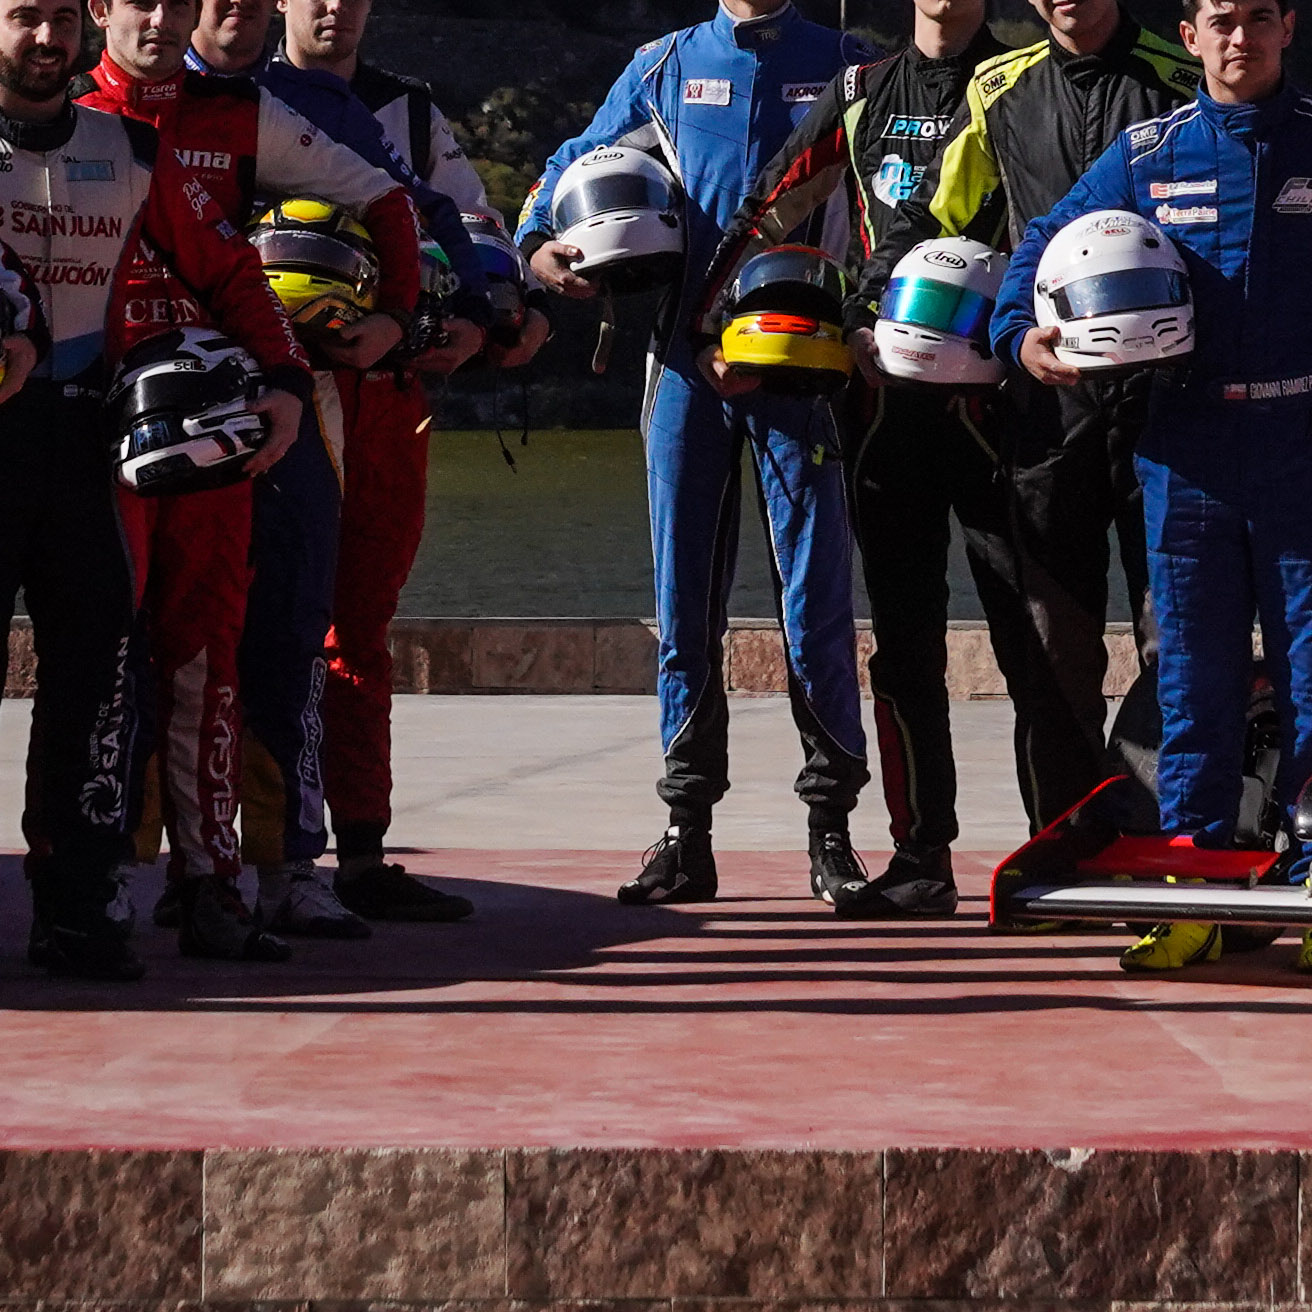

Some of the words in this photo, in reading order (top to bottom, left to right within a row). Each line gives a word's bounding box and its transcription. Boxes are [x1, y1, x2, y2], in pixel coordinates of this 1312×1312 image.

[983, 74, 1007, 94] OMP
[1131, 125, 1159, 142] OMP
[11, 210, 66, 237] SAN
[69, 215, 122, 238] JUAN
[1104, 227, 1127, 236] BELL
[935, 251, 962, 266] Arai
